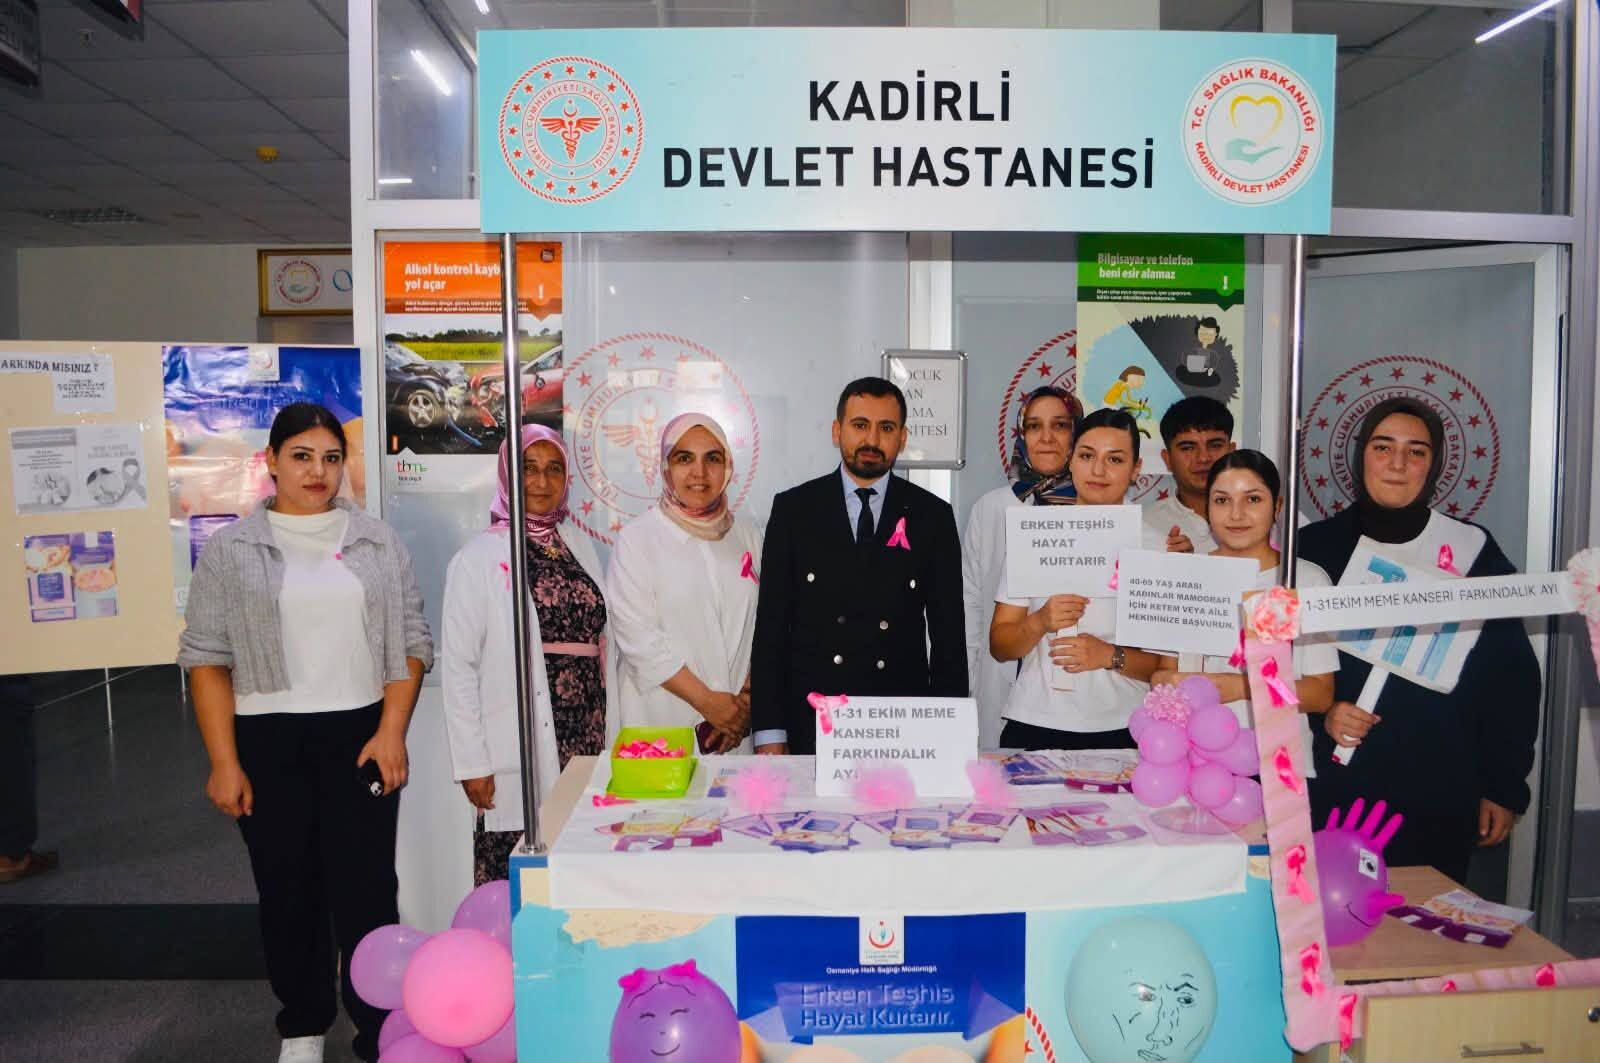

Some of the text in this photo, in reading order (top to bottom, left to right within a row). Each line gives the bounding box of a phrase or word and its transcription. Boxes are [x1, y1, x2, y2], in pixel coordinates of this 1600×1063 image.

[809, 70, 1010, 121] KADİRLİ
[1191, 68, 1316, 132] T.C. SAĞLIK BAKANLIĞI
[526, 132, 551, 170] TÜRKİYE
[664, 138, 1154, 188] DEVLET HASTANESİ
[1195, 141, 1223, 182] KADİRLİ
[1222, 178, 1263, 193] DEVLET
[1097, 253, 1194, 266] Bilgisayar ve telefon
[405, 263, 502, 278] Alkol kontrol kayb
[1099, 266, 1176, 280] beni esir alamaz
[405, 278, 446, 292] yol açar
[0, 359, 50, 371] ARKINDA
[893, 369, 943, 381] OCUK
[904, 388, 923, 400] AN
[907, 407, 935, 418] MA
[908, 423, 947, 436] NİTESİ
[1431, 434, 1459, 501] BAKANLIĞ
[1334, 453, 1361, 498] ÜRKİYE
[1020, 517, 1115, 532] ERKEN TEŞHİS
[1032, 538, 1076, 549] HAYAT
[1039, 556, 1107, 567] KURTARIR
[1155, 579, 1173, 589] YAŞ
[1176, 581, 1202, 590] ARASI
[1129, 590, 1174, 600] KADINLAR
[1364, 593, 1401, 608] MEME
[1402, 588, 1454, 605] KANSERİ
[1459, 584, 1536, 601] FARKINDALIK
[1540, 583, 1559, 596] AYI
[1129, 600, 1229, 617] İÇİN KETEM VEYA AİLE
[1128, 613, 1180, 624] HEKİMİNİZE
[833, 705, 957, 719] 1-31 EKİM MEME
[833, 727, 900, 739] KANSERİ
[833, 749, 937, 760] FARKINDALIK
[802, 982, 955, 1009] Erken Teşhis
[801, 1007, 955, 1033] Hayat Kurtarır.
